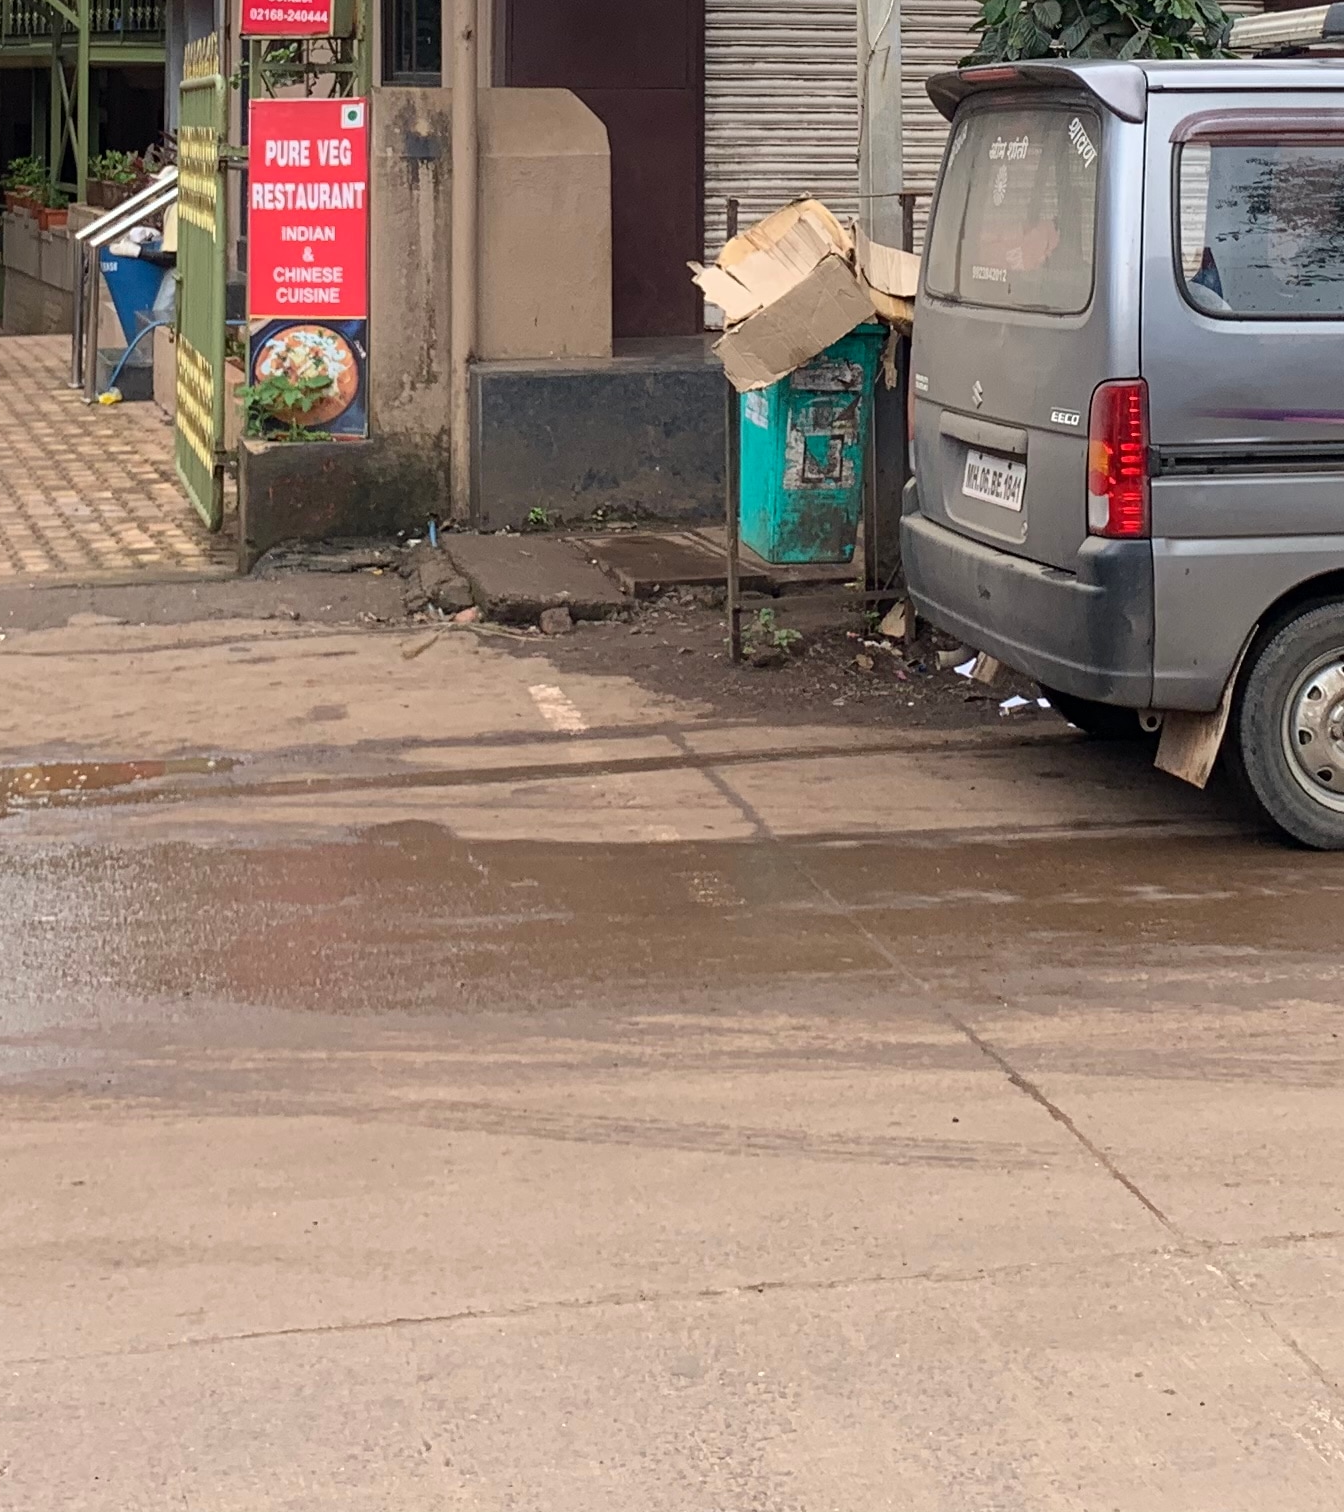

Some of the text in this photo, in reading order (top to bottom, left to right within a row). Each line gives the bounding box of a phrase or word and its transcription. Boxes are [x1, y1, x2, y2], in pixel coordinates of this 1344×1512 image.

[250, 8, 328, 24] 02168-240444
[265, 139, 352, 167] PURE VEG
[252, 182, 365, 210] RESTAURANT
[281, 226, 335, 241] INDIAN
[302, 246, 314, 262] &
[273, 267, 343, 283] CHINESE
[276, 287, 340, 303] CUISINE
[1051, 411, 1080, 426] EECO
